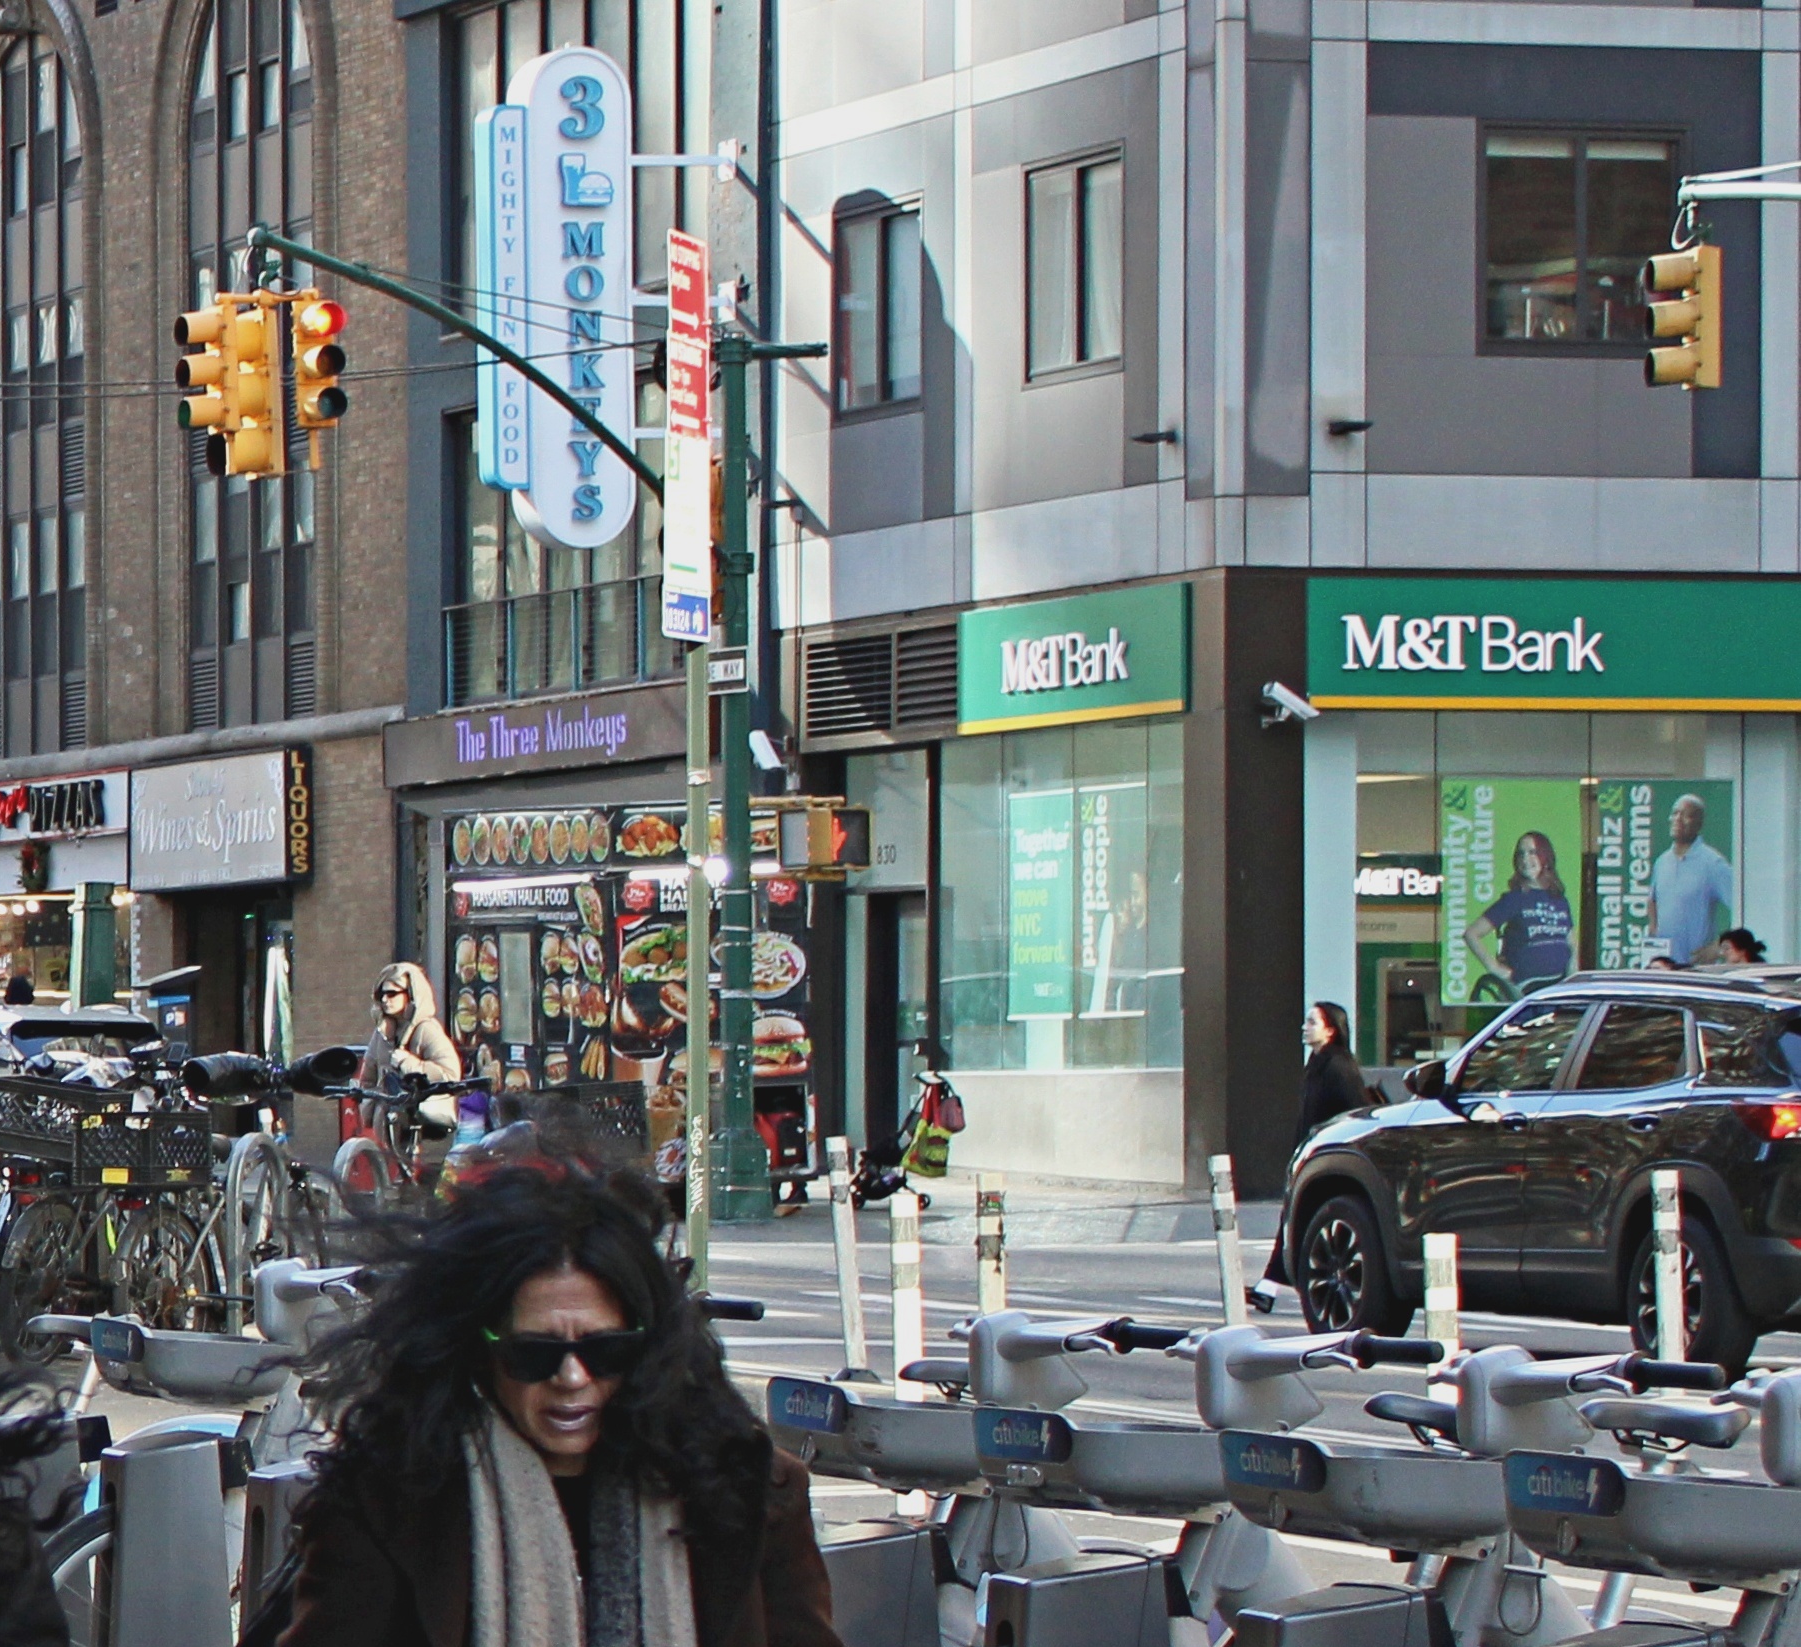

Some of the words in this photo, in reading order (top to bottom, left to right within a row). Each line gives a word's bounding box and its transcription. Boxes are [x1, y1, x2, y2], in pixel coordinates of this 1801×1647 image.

[559, 75, 605, 140] 3
[500, 127, 517, 253] MIGHTY
[503, 277, 516, 345] FIN
[562, 222, 605, 520] MONKEYS
[503, 382, 519, 464] FOOD
[724, 663, 740, 679] WAY
[1000, 634, 1065, 693] M&T
[1065, 627, 1129, 687] Bank
[1341, 614, 1476, 671] M&T
[1481, 614, 1605, 672] Bank
[455, 719, 486, 763] The
[489, 714, 539, 759] Three
[546, 705, 627, 757] Monkeys
[30, 779, 105, 833] PIZZAS
[136, 802, 194, 854] Wines
[196, 806, 212, 847] &
[211, 795, 277, 864] Spirits
[289, 751, 309, 873] LIQUORS
[1443, 785, 1467, 811] &
[1599, 785, 1623, 813] &
[877, 844, 897, 864] 830
[1013, 827, 1070, 856] Together
[1013, 861, 1033, 880] we
[1034, 859, 1058, 879] can
[1094, 794, 1111, 910] people
[1469, 785, 1494, 902] culture
[1597, 817, 1622, 867] biz
[1622, 784, 1651, 917] dreams
[517, 888, 544, 906] HALAL
[545, 888, 569, 905] FOOD
[1013, 888, 1047, 908] move
[1013, 913, 1041, 936] NYC
[1082, 827, 1097, 968] purpose
[1442, 814, 1474, 1000] community
[1596, 875, 1622, 968] small
